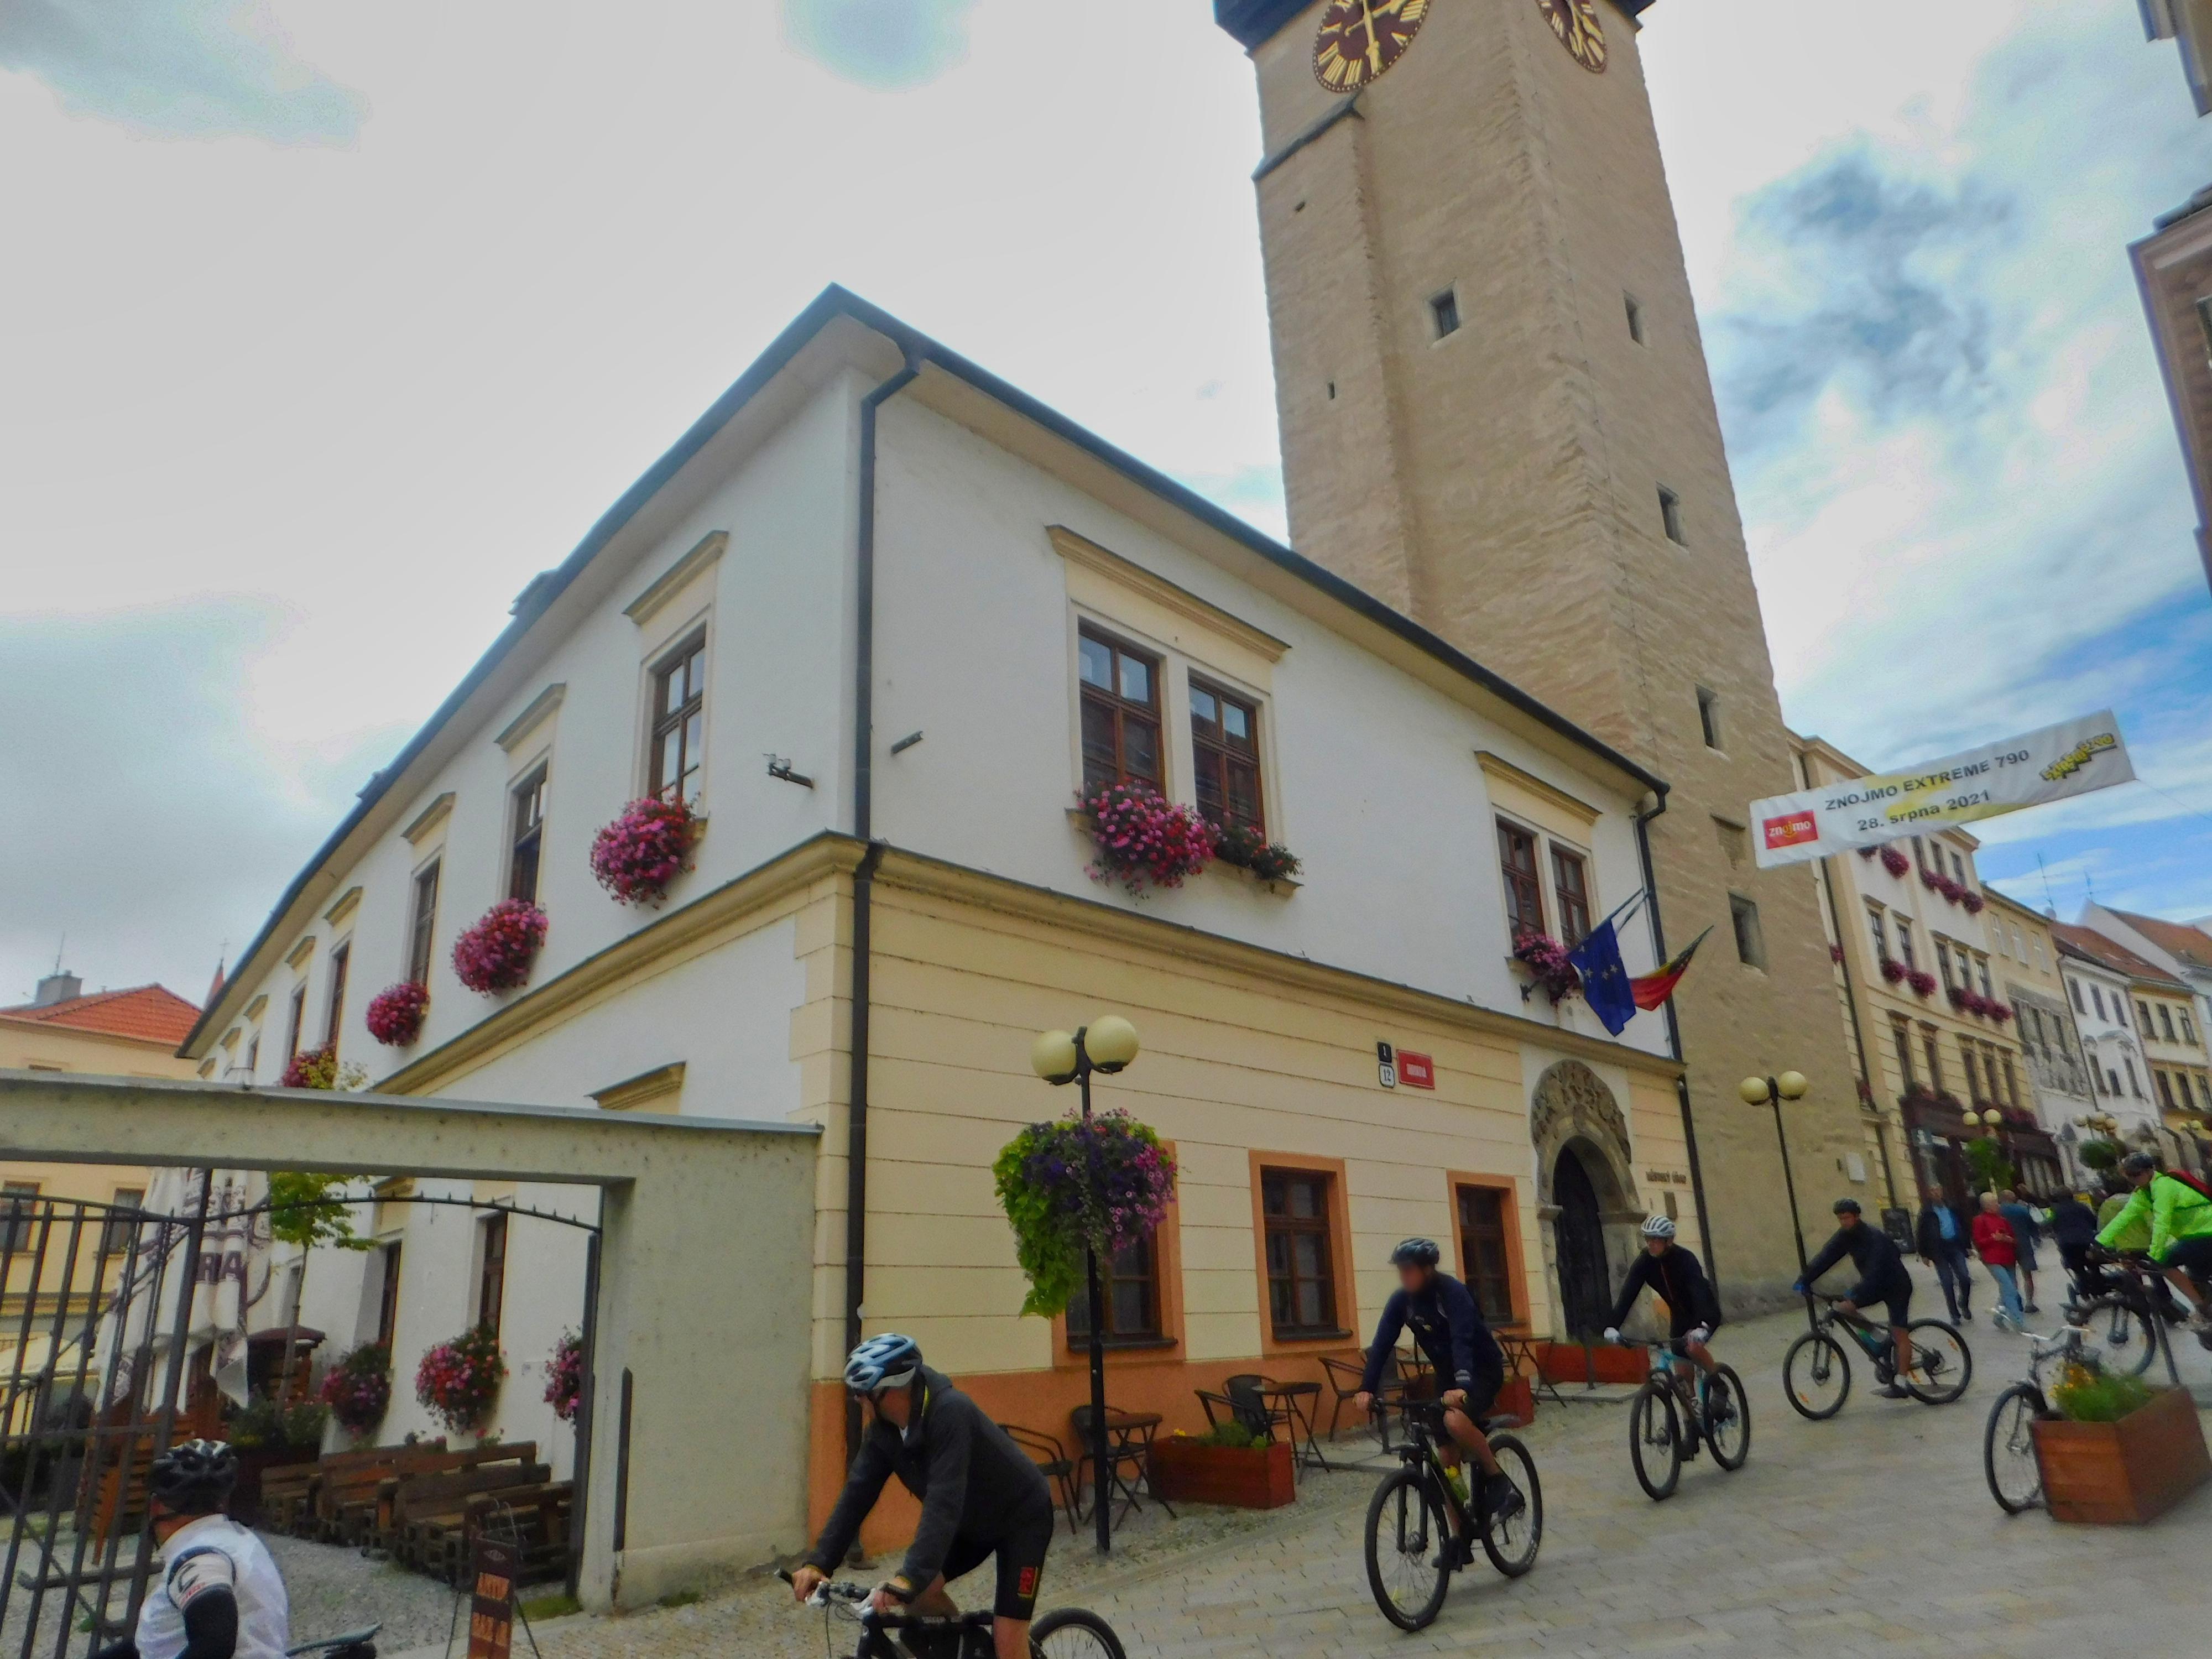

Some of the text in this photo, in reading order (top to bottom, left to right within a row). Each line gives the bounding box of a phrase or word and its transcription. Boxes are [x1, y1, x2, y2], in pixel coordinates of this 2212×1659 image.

[1825, 785, 1898, 811] ZNOJMO
[1903, 760, 1990, 792] EXTREME
[1994, 749, 2030, 768] 790
[1857, 789, 1990, 831] 28. srpna 2021
[1383, 1068, 1391, 1082] 12
